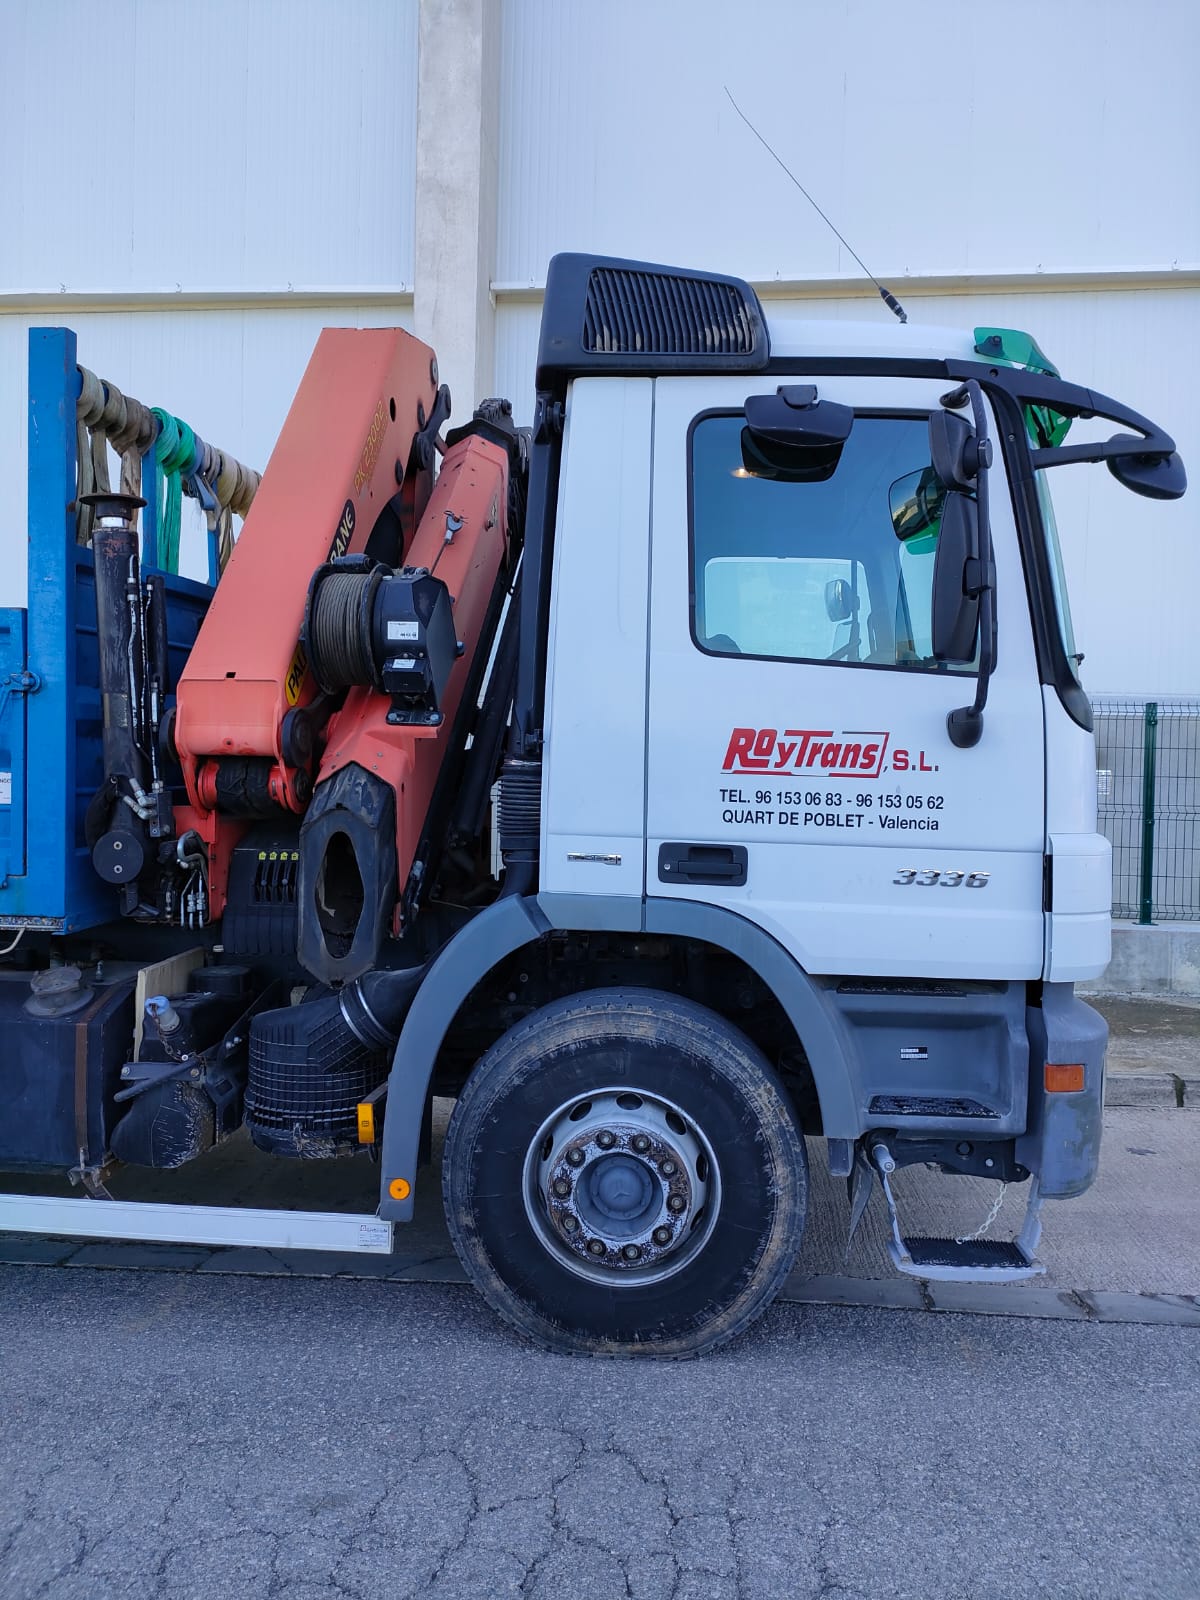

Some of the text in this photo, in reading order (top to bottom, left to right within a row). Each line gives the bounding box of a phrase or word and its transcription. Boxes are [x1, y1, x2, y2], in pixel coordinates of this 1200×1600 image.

[330, 507, 353, 564] RANE
[892, 749, 939, 772] S.L.
[720, 789, 750, 803] TEL.
[755, 790, 772, 804] 96
[777, 791, 801, 805] 153
[805, 792, 821, 806] 06
[825, 793, 842, 806] 83
[856, 794, 873, 807] 96
[877, 795, 902, 808] 153
[906, 795, 923, 809] 05
[927, 796, 944, 810] 62
[722, 810, 774, 825] QUART
[778, 812, 799, 825] DE
[804, 813, 864, 828] POBLET
[879, 815, 939, 830] Valencia
[892, 868, 992, 888] 3336
